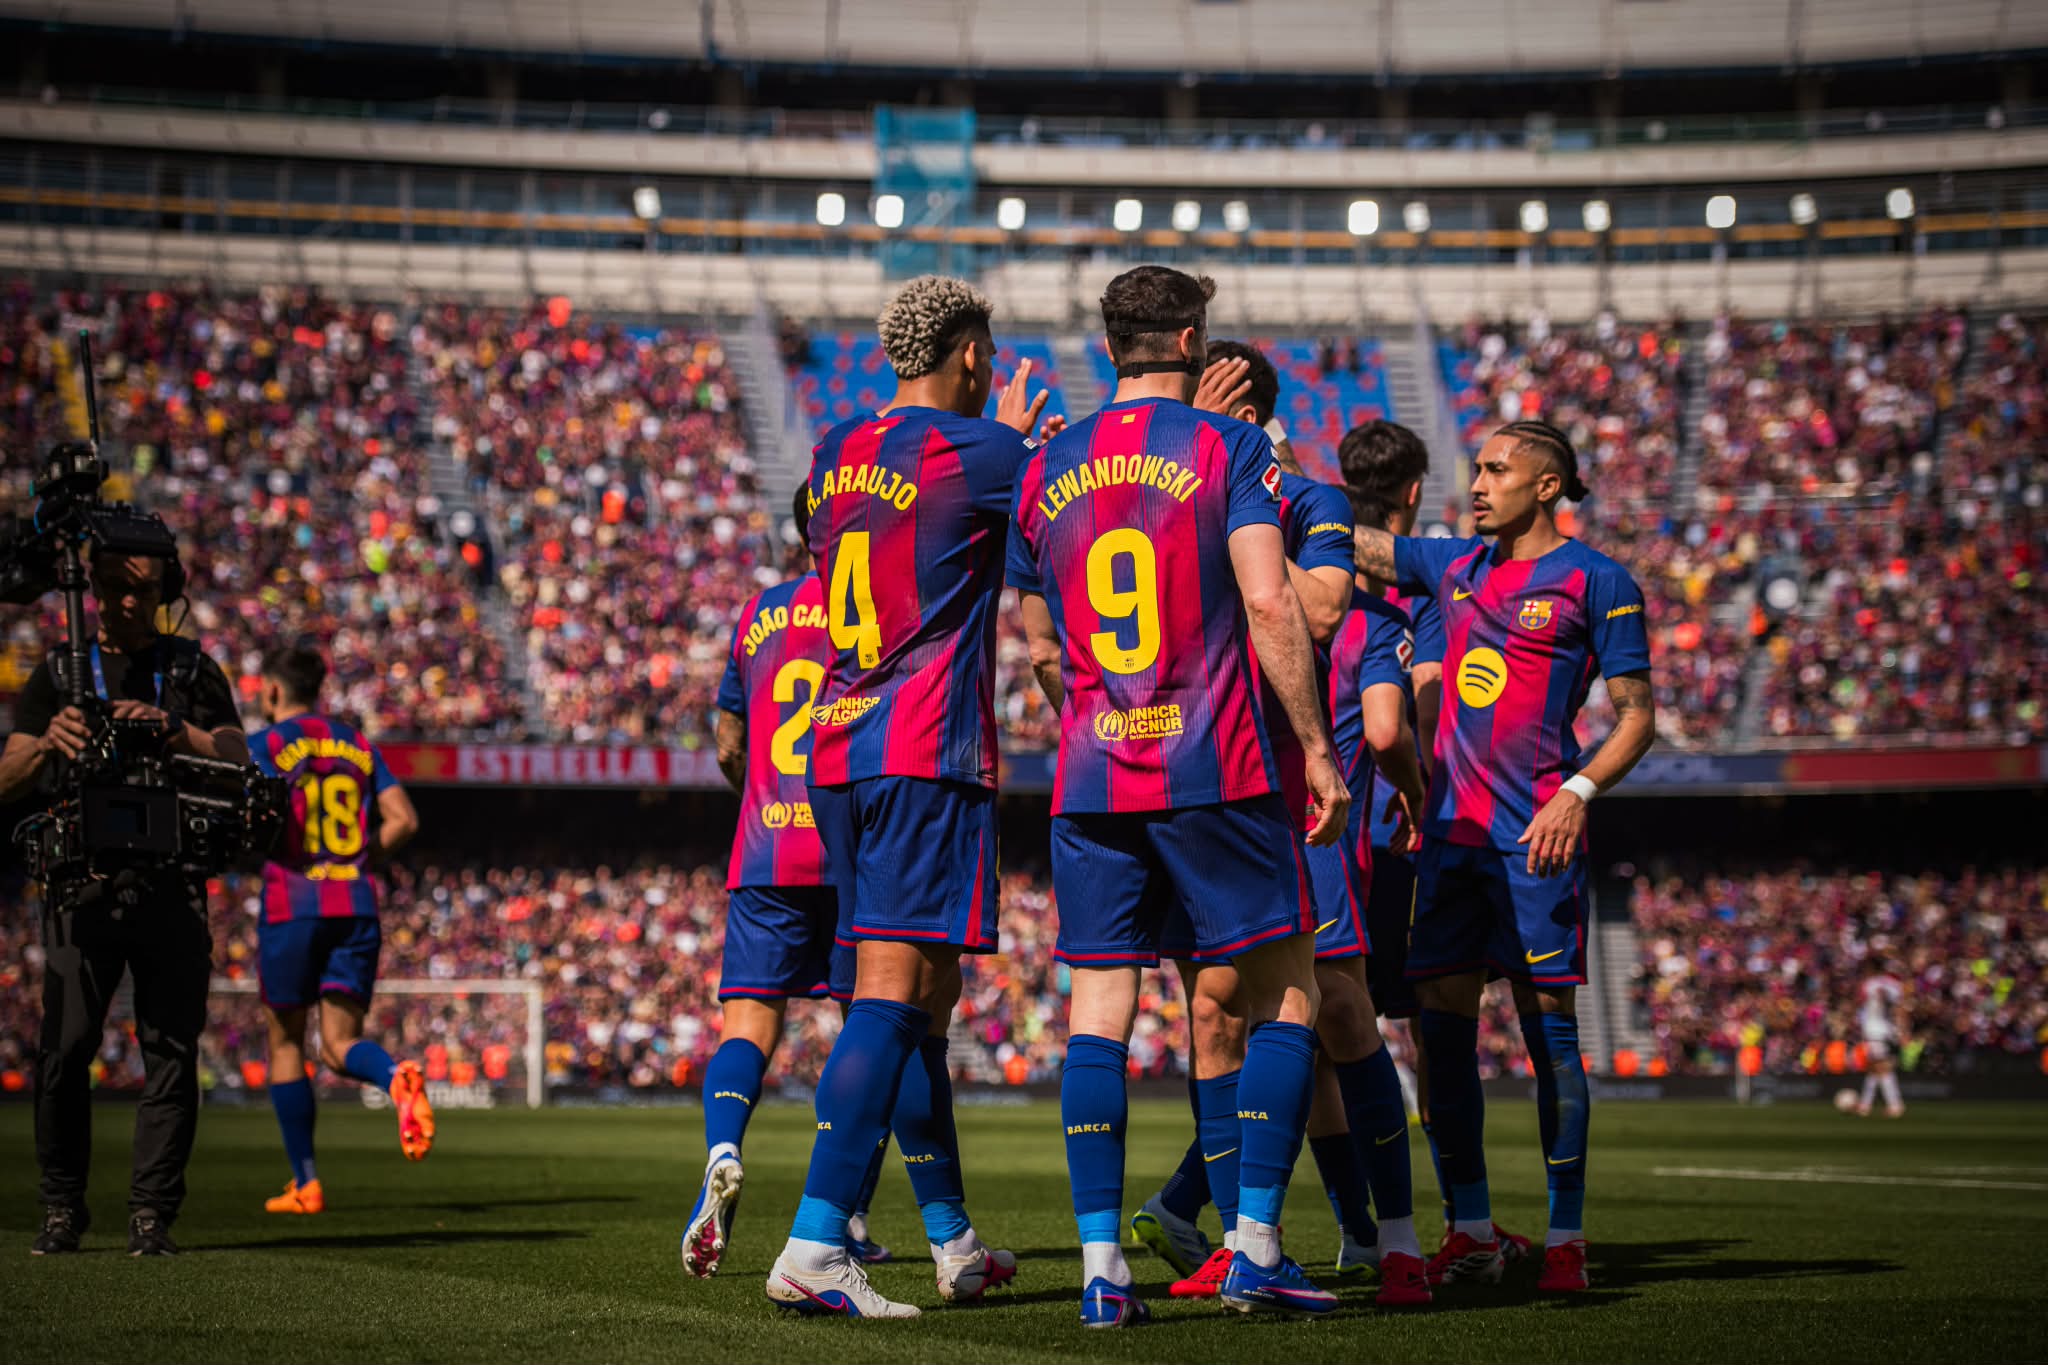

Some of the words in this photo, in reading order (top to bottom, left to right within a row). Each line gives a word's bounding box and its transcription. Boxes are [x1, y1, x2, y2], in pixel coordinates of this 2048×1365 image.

[822, 463, 918, 511] ARAUJO
[1037, 454, 1203, 522] LEWANDOWSKI
[829, 531, 882, 670] 4
[1086, 528, 1160, 675] 9
[742, 605, 789, 657] JOÃO
[771, 658, 826, 775] 2
[1128, 704, 1181, 722] UNHCR
[1128, 717, 1183, 735] ACNUR
[458, 746, 658, 785] ESTRELLA
[668, 747, 727, 786] DA
[296, 773, 362, 856] 18
